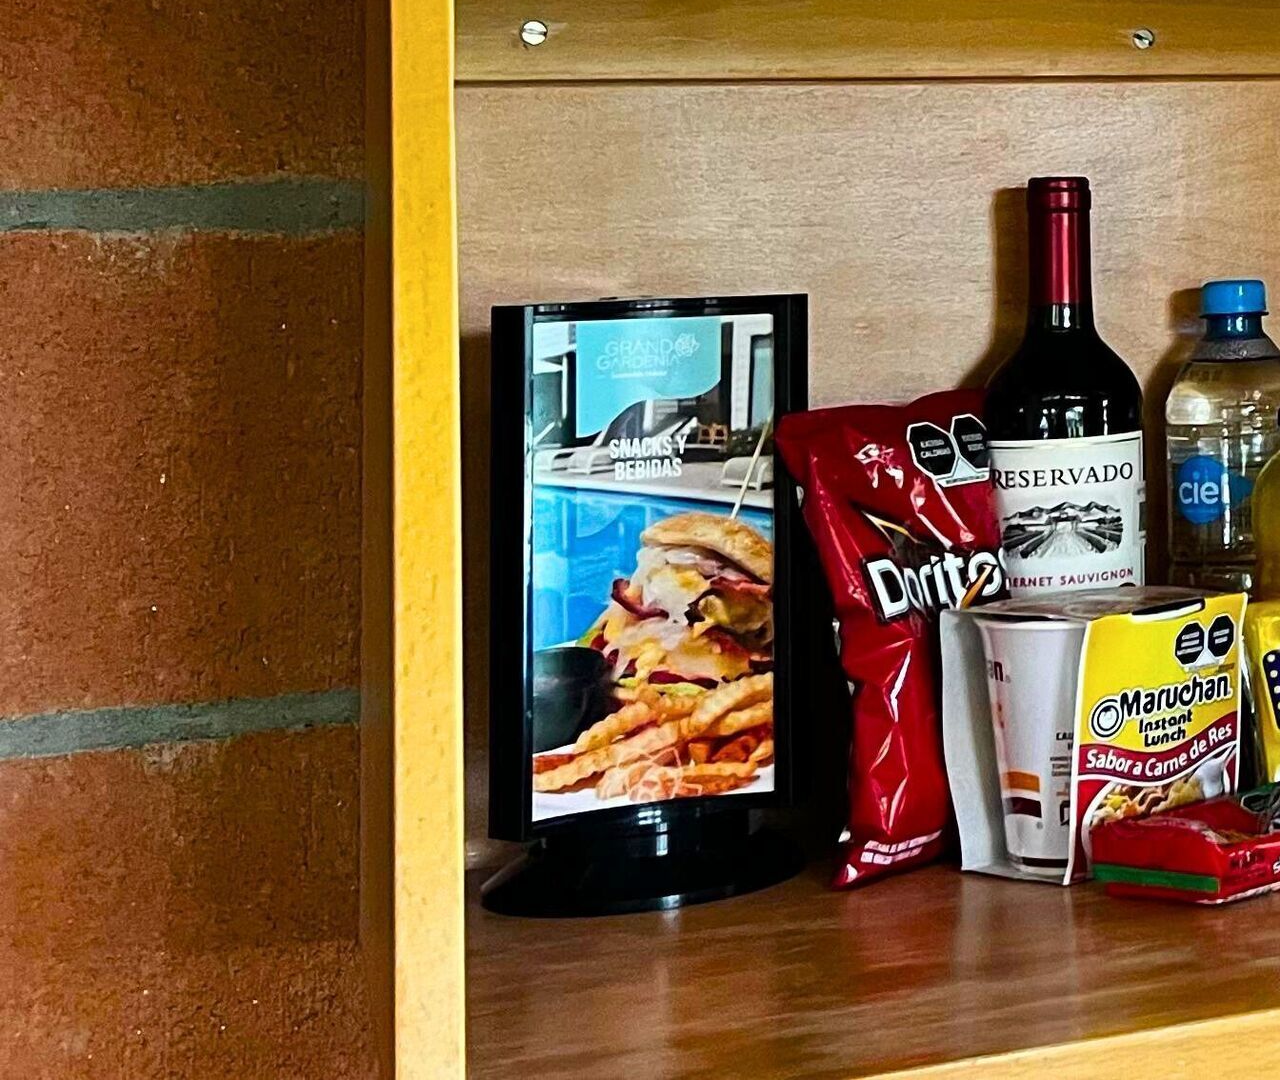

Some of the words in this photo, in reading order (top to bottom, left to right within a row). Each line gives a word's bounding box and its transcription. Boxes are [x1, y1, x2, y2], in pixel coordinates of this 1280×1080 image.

[604, 338, 674, 357] GRAND
[596, 354, 680, 371] GARDENIA
[608, 437, 673, 460] SNACKS
[677, 434, 688, 455] Y
[614, 457, 683, 481] BEBIDAS
[992, 462, 1133, 489] RESERVADO
[867, 547, 1005, 619] Dorito
[1060, 567, 1134, 586] SAUVIGNON
[1119, 675, 1229, 718] Maruchan
[1139, 709, 1193, 734] Instant
[1144, 726, 1187, 748] Lunch
[1086, 749, 1133, 775] Sabor
[1132, 763, 1143, 776] a
[1145, 753, 1188, 777] Carne
[1189, 737, 1208, 760] de
[1208, 723, 1233, 748] Res
